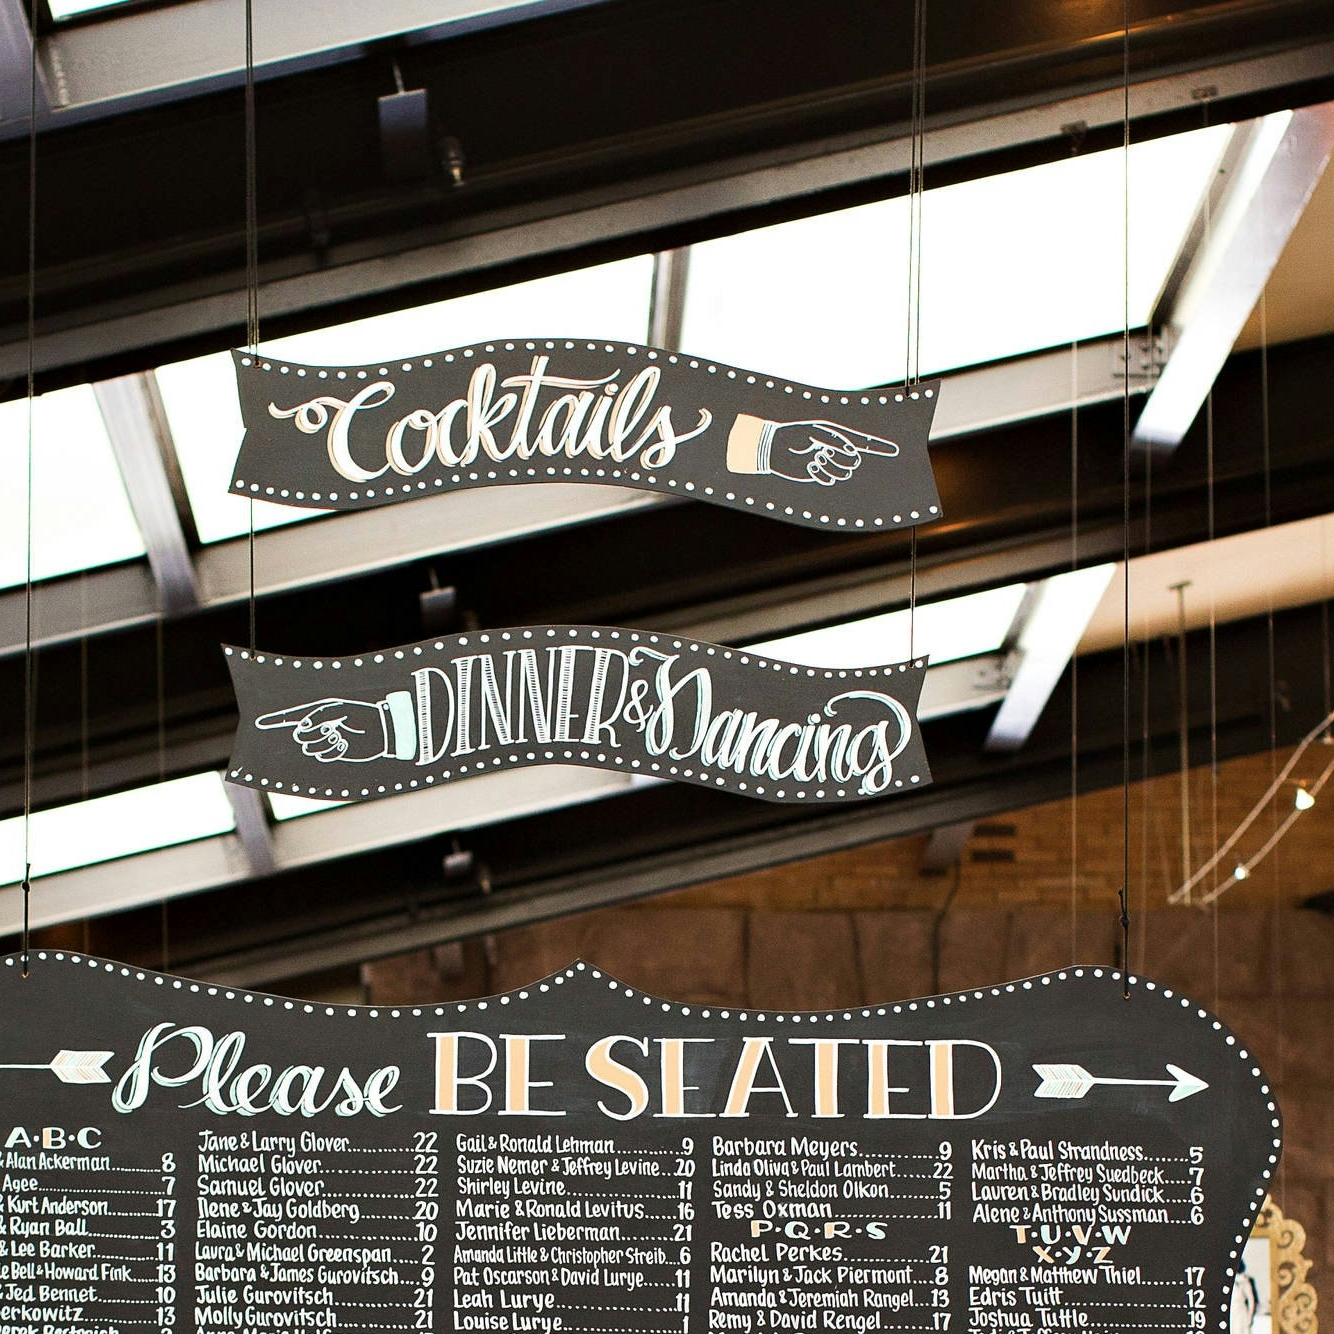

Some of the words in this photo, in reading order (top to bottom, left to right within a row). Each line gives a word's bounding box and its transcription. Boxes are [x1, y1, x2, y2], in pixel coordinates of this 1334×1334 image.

[267, 355, 713, 482] Cocktails
[411, 645, 637, 768] DINNER
[622, 678, 653, 732] &
[628, 646, 912, 796] Dancing
[111, 1022, 404, 1117] Please
[426, 1031, 567, 1118] BE
[586, 1033, 1002, 1120] SEATED
[712, 1135, 787, 1157] Barbara
[790, 1136, 858, 1162] Meyers
[938, 1140, 953, 1161] 9
[971, 1138, 1007, 1161] Kris
[1008, 1141, 1020, 1157] &
[1019, 1138, 1055, 1161] Paul
[1057, 1140, 1144, 1162] Strandness
[1189, 1146, 1204, 1165] 5
[5, 1151, 38, 1171] Alan
[38, 1151, 111, 1172] Ackerman
[161, 1152, 177, 1173] 8
[198, 1152, 266, 1174] Michael
[270, 1154, 322, 1175] Glover
[413, 1153, 439, 1175] 22
[1, 1173, 39, 1194] Agee
[161, 1175, 176, 1196] 7
[710, 1200, 755, 1220] Tess
[762, 1199, 833, 1219] Oxman
[936, 1200, 952, 1221] 11
[196, 1219, 248, 1240] Elaine
[253, 1219, 317, 1240] Gordon
[415, 1220, 438, 1243] 10
[454, 1220, 531, 1242] Jennifer
[533, 1221, 621, 1242] Lieberman
[672, 1223, 693, 1242] 21
[710, 1241, 770, 1263] Rachel
[775, 1242, 843, 1263] Perkes
[928, 1244, 949, 1265] 21
[969, 1286, 1017, 1307] Edris
[1017, 1286, 1064, 1307] Tuitt
[1185, 1288, 1207, 1309] 12
[155, 1305, 176, 1327] 13
[453, 1310, 510, 1331] Louise
[682, 1315, 690, 1334] 1
